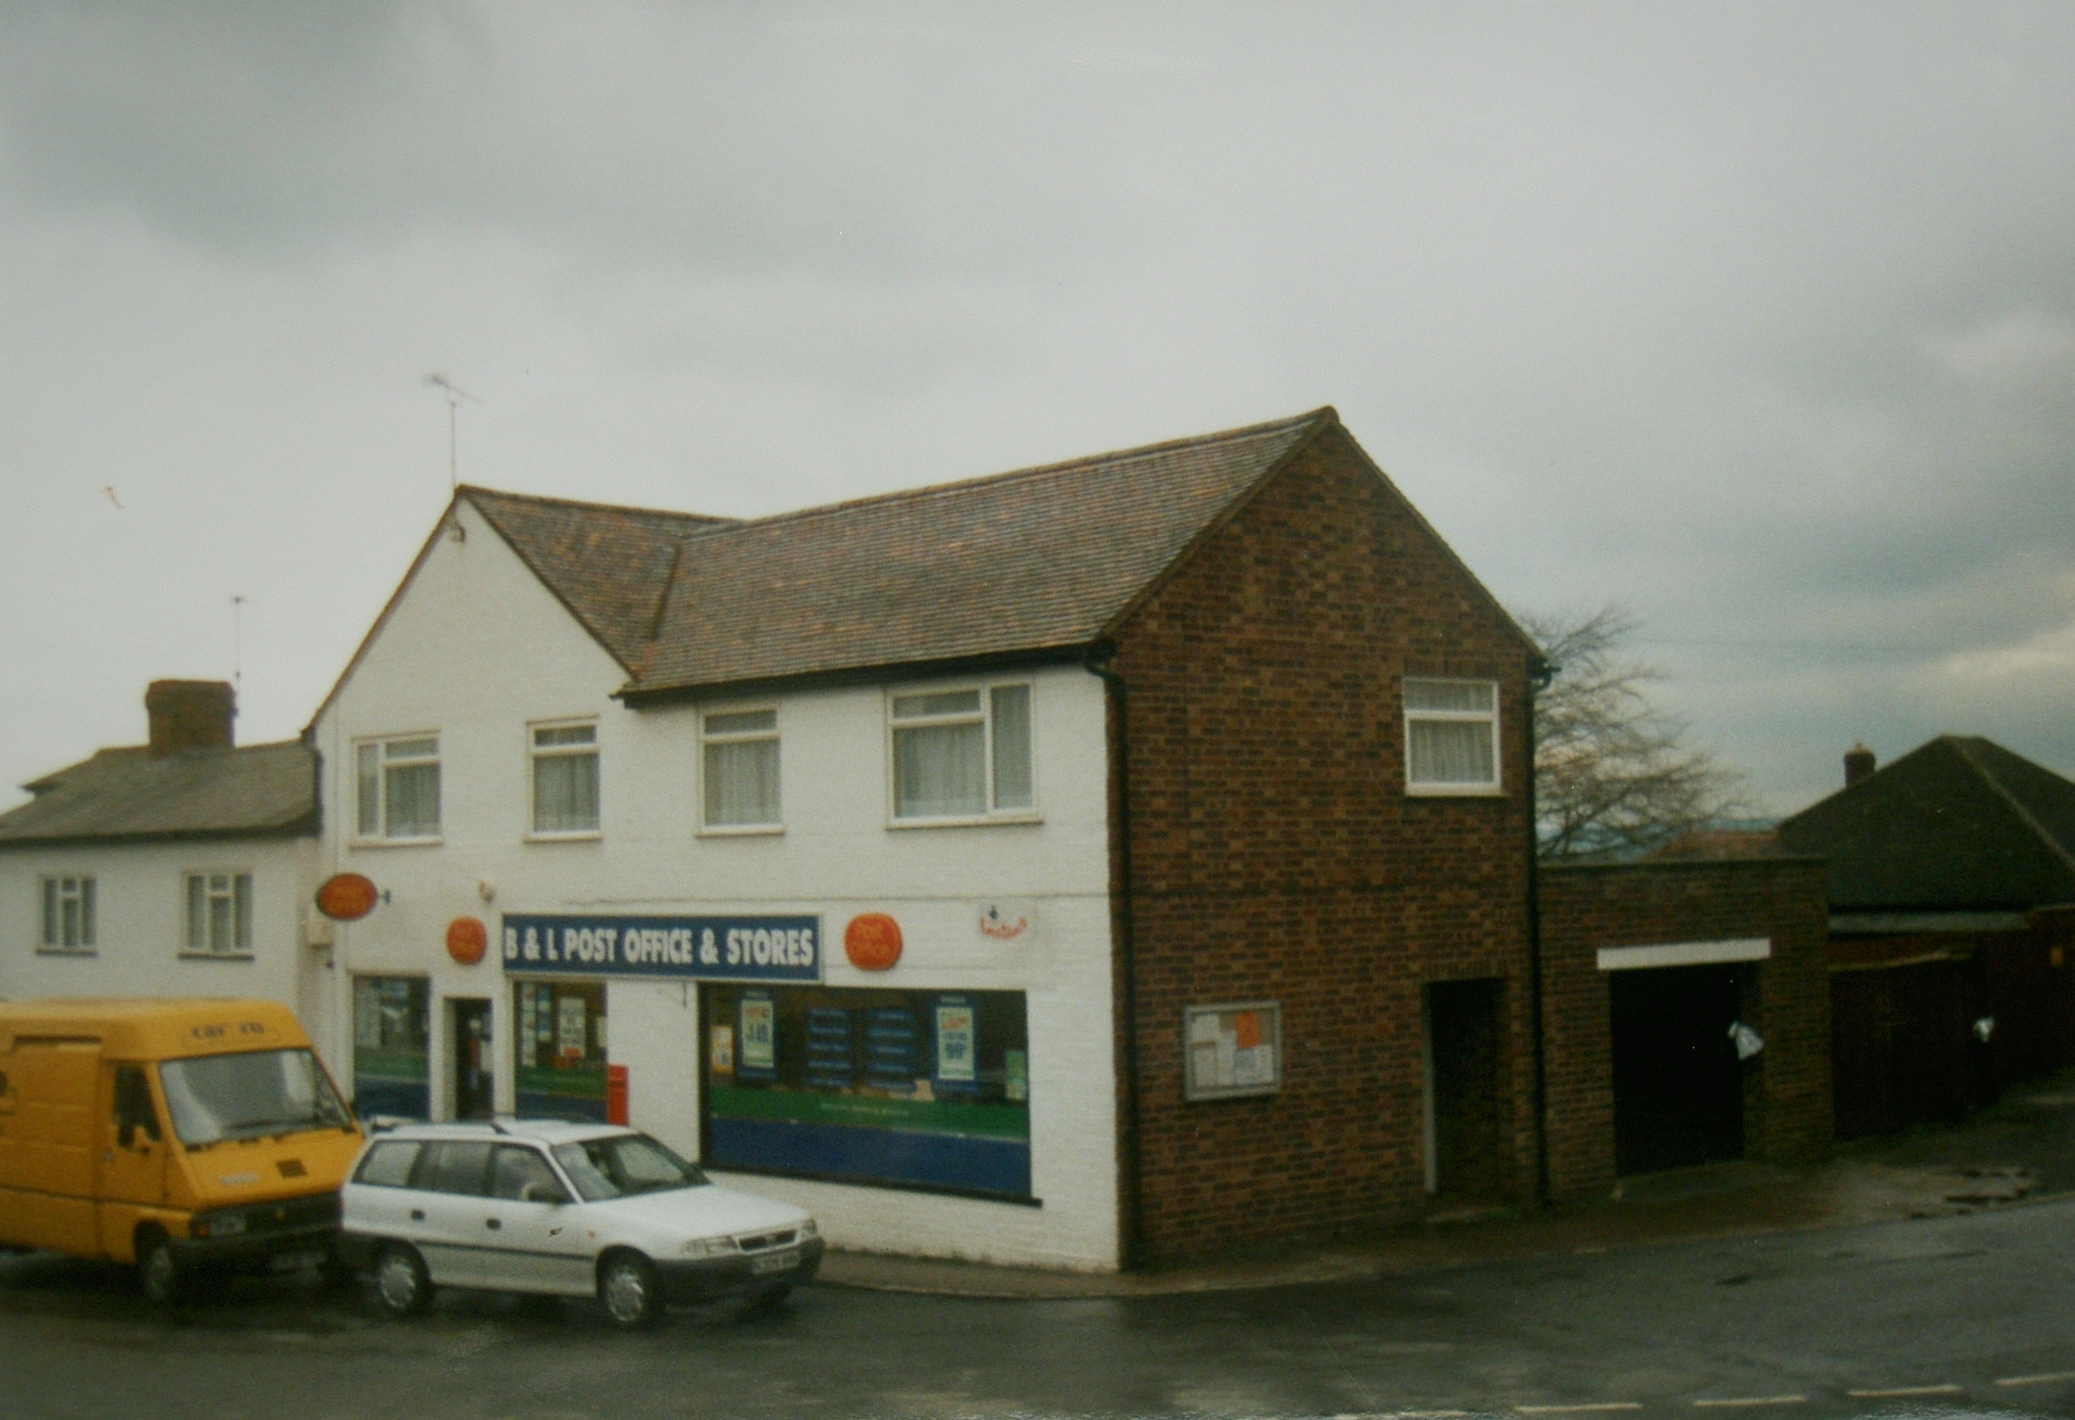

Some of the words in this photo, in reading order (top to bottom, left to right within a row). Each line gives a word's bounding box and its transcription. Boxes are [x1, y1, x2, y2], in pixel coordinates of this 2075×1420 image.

[505, 927, 518, 960] B
[525, 928, 541, 960] &
[546, 928, 558, 961] L
[565, 928, 618, 963] POST
[625, 928, 693, 964] OFFICE
[701, 928, 719, 965] &
[727, 929, 814, 967] STORES
